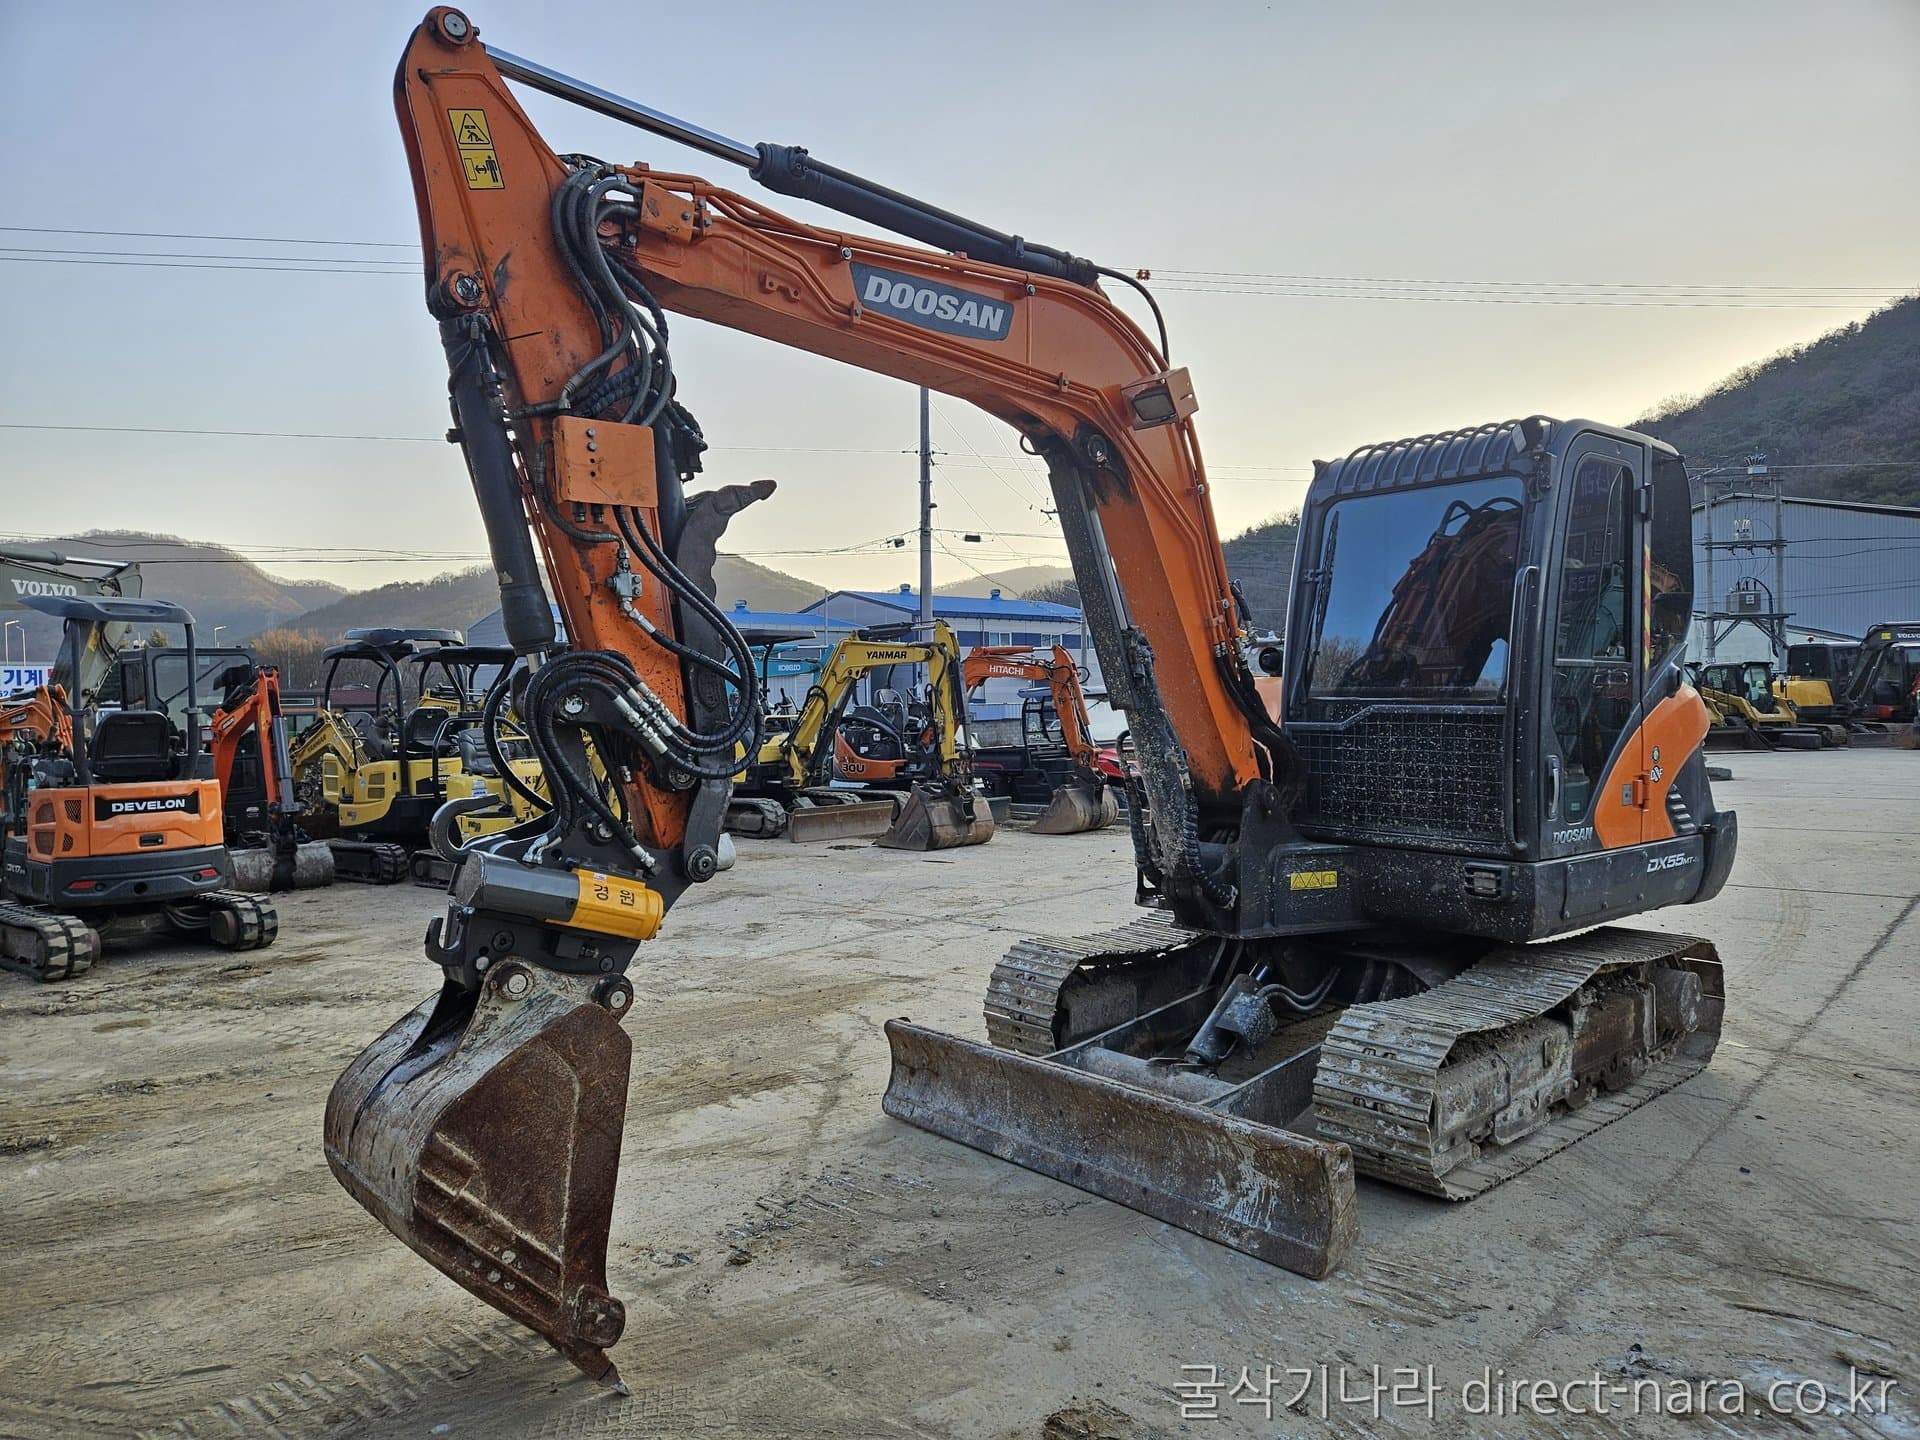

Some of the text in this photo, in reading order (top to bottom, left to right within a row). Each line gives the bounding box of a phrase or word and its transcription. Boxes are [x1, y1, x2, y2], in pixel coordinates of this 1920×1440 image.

[864, 275, 1005, 332] DOOSAN
[11, 579, 77, 596] VOLVO
[866, 651, 908, 659] YANMAR
[989, 664, 1024, 676] HITACHI
[842, 764, 865, 773] 30U
[111, 798, 186, 812] DEVELON
[1552, 826, 1594, 844] DOOSAN
